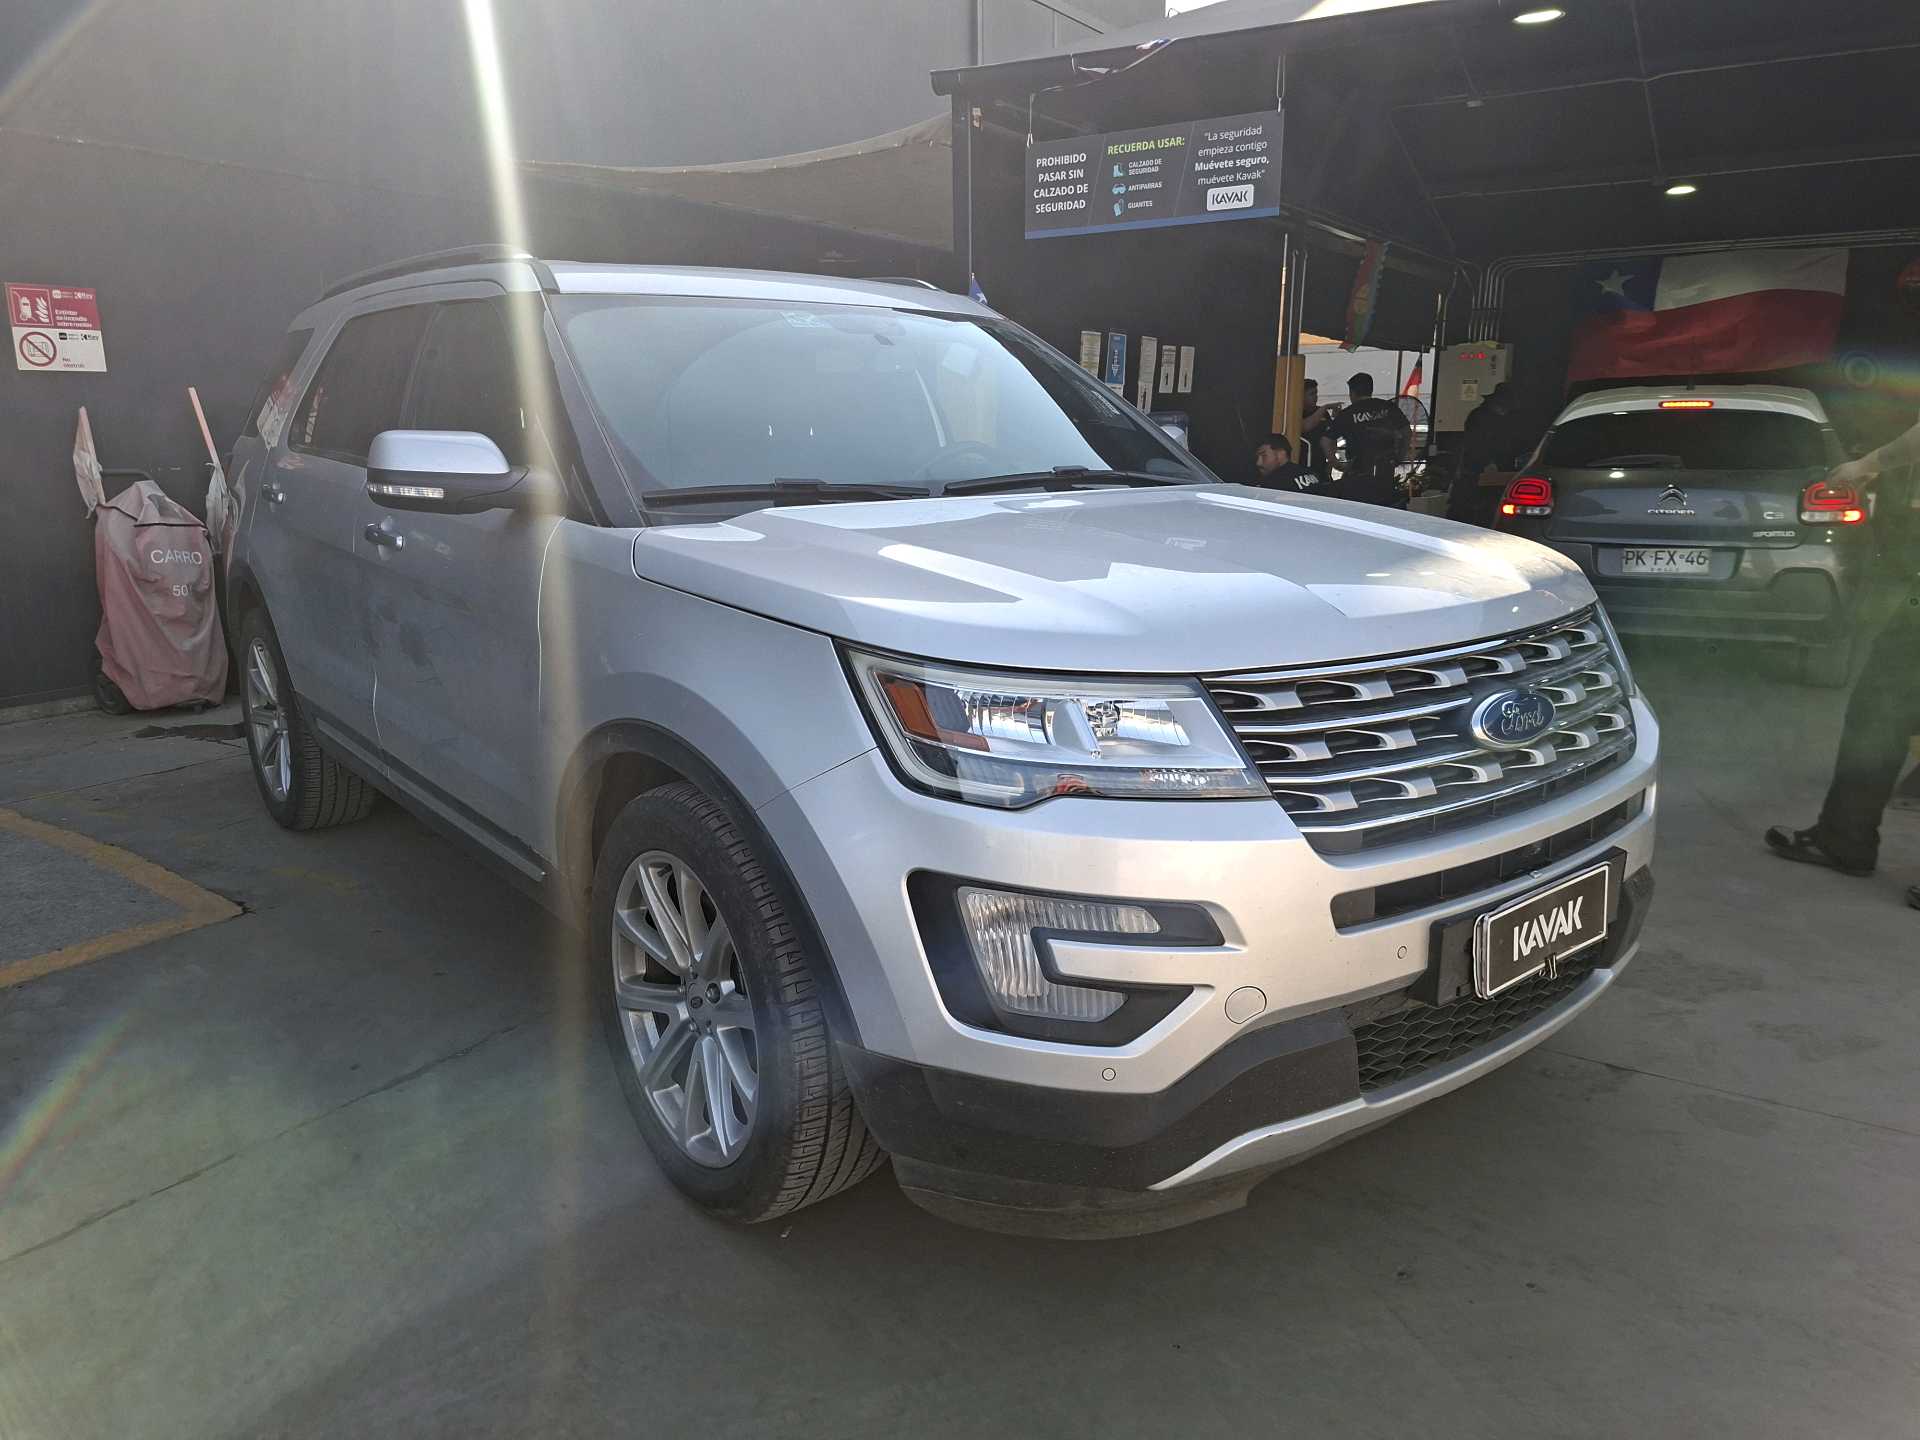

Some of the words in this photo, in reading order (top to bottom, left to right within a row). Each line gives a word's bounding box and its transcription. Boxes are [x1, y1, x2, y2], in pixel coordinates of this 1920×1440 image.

[1219, 125, 1262, 141] seguridad
[1107, 140, 1156, 156] RECUERDA
[1157, 136, 1185, 149] USAR:
[1198, 145, 1234, 157] empieza
[1235, 140, 1268, 152] contigo
[1036, 152, 1087, 169] PROHIBIDO
[1128, 159, 1154, 169] CALZADO
[1194, 160, 1234, 172] Muévete
[1235, 155, 1270, 168] seguro,
[1038, 170, 1067, 183] PASAR
[1068, 168, 1084, 180] SIN
[1197, 174, 1235, 186] muévete
[1033, 184, 1075, 199] CALZADO
[1076, 183, 1089, 194] DE
[1211, 190, 1249, 206] KAVAK
[1035, 199, 1086, 215] SEGURIDAD
[1763, 511, 1785, 520] C3
[150, 549, 203, 565] CARRO
[172, 584, 189, 597] 50
[1501, 700, 1545, 736] Ford
[1512, 895, 1584, 963] KAVAK
